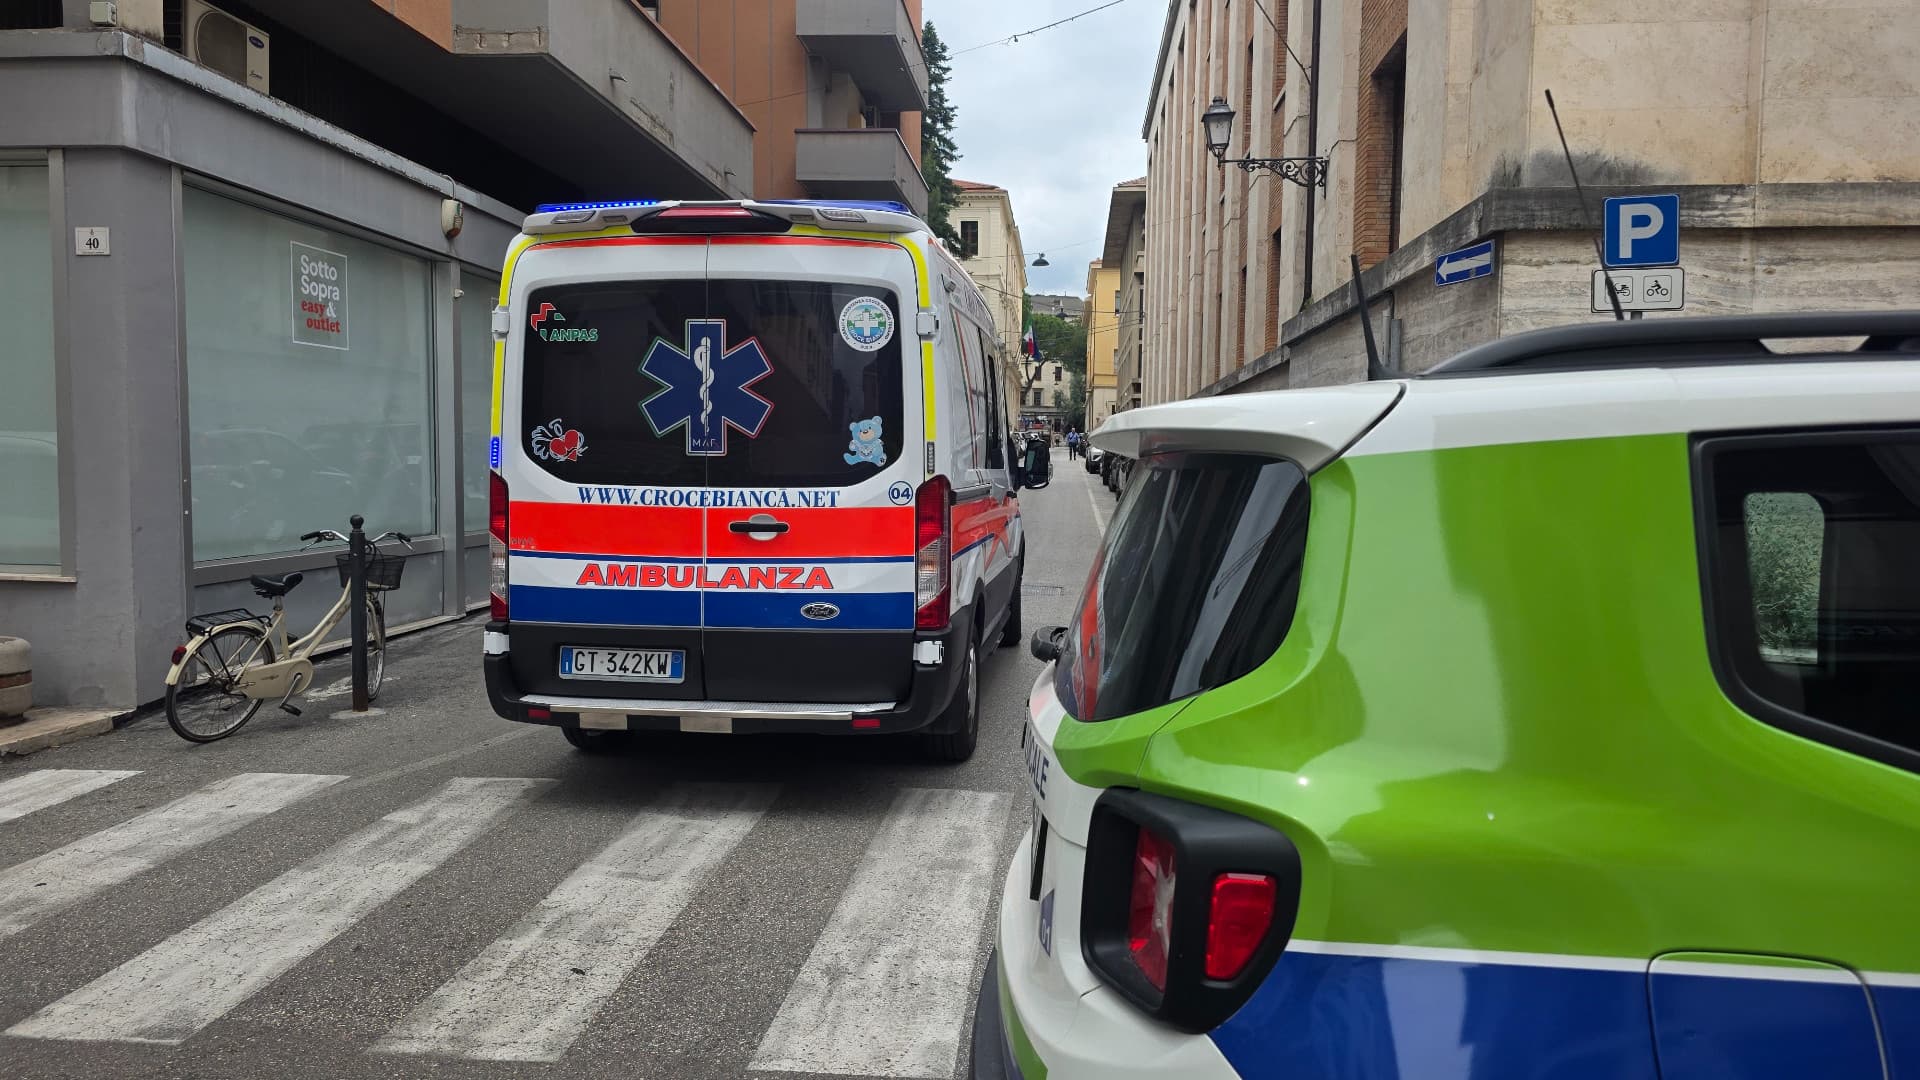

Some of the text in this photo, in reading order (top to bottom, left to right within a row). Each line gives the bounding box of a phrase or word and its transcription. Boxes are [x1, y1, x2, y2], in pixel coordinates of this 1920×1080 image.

[1618, 203, 1664, 259] P
[85, 237, 100, 249] 40
[300, 254, 337, 281] Sotto
[300, 275, 340, 301] Sopra
[306, 318, 341, 333] outlet
[550, 328, 598, 342] ANPAS
[577, 486, 840, 508] WWW.CROCEBIANCA.NET
[890, 487, 911, 500] 04
[576, 563, 834, 590] AMBULANZA
[574, 651, 599, 673] GT
[606, 652, 669, 675] 342KW
